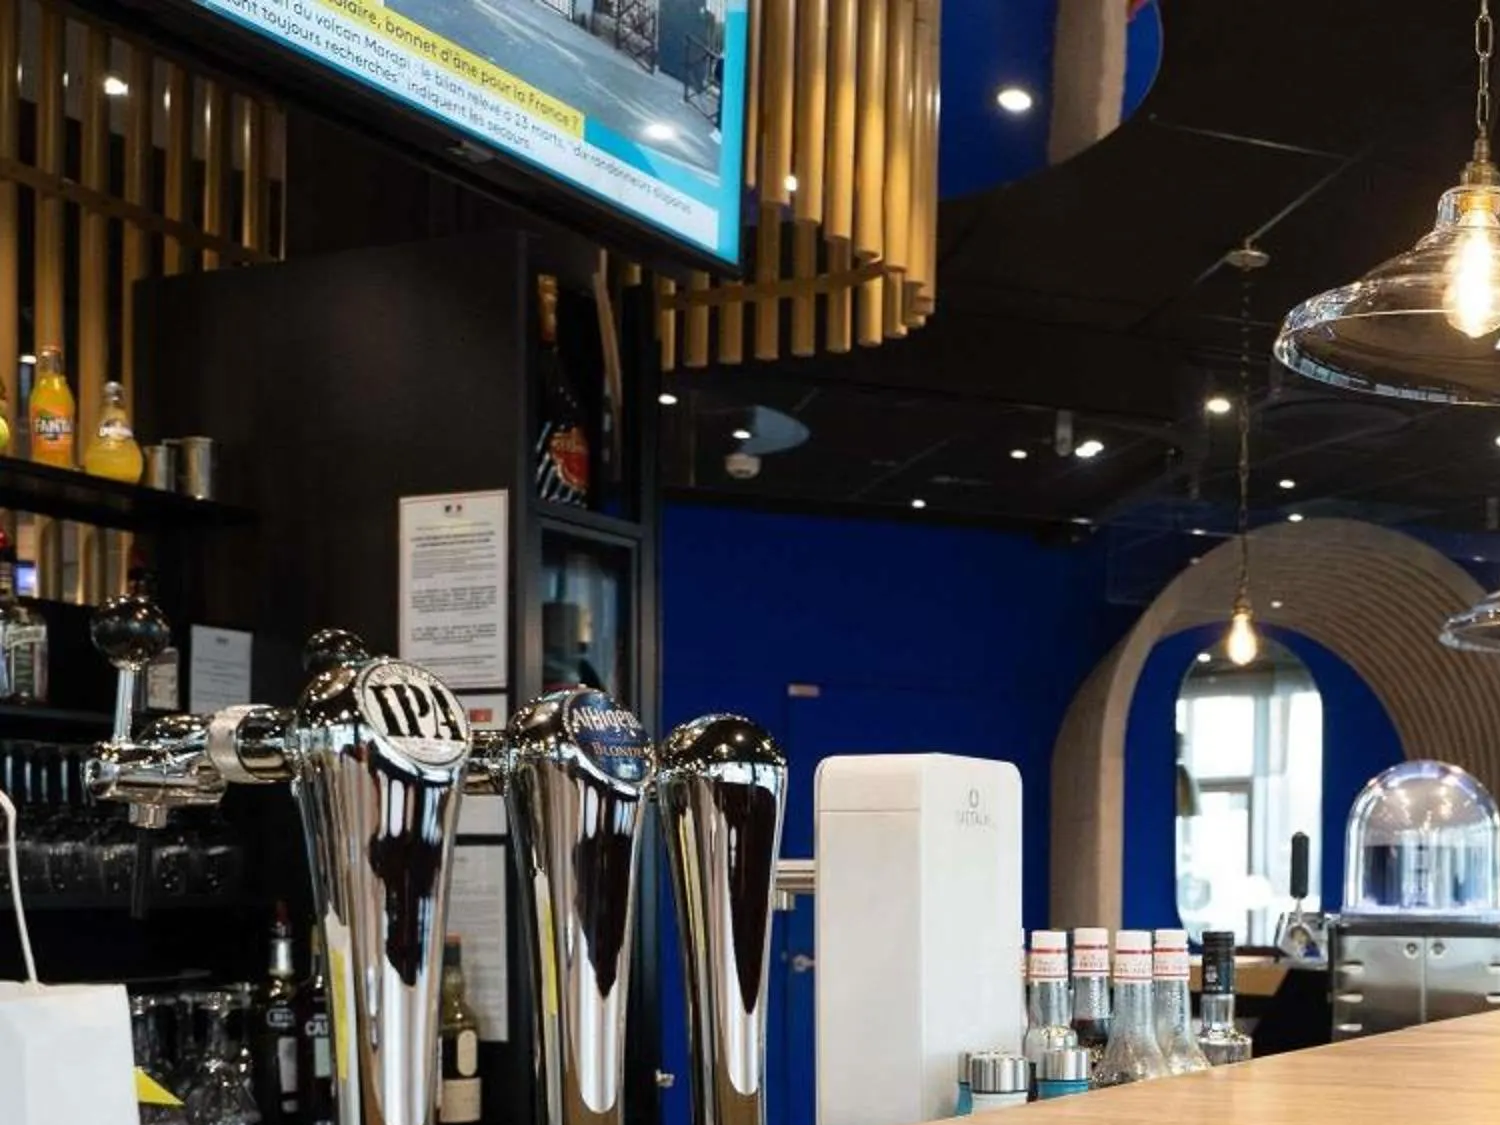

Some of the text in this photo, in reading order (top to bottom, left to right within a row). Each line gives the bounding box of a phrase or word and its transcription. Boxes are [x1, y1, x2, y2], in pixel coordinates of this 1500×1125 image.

[261, 6, 320, 47] toujours
[293, 2, 313, 20] du
[315, 13, 361, 44] volcan
[385, 17, 437, 57] bonnet
[481, 70, 513, 95] pour
[528, 92, 571, 127] France
[367, 683, 466, 741] IPA
